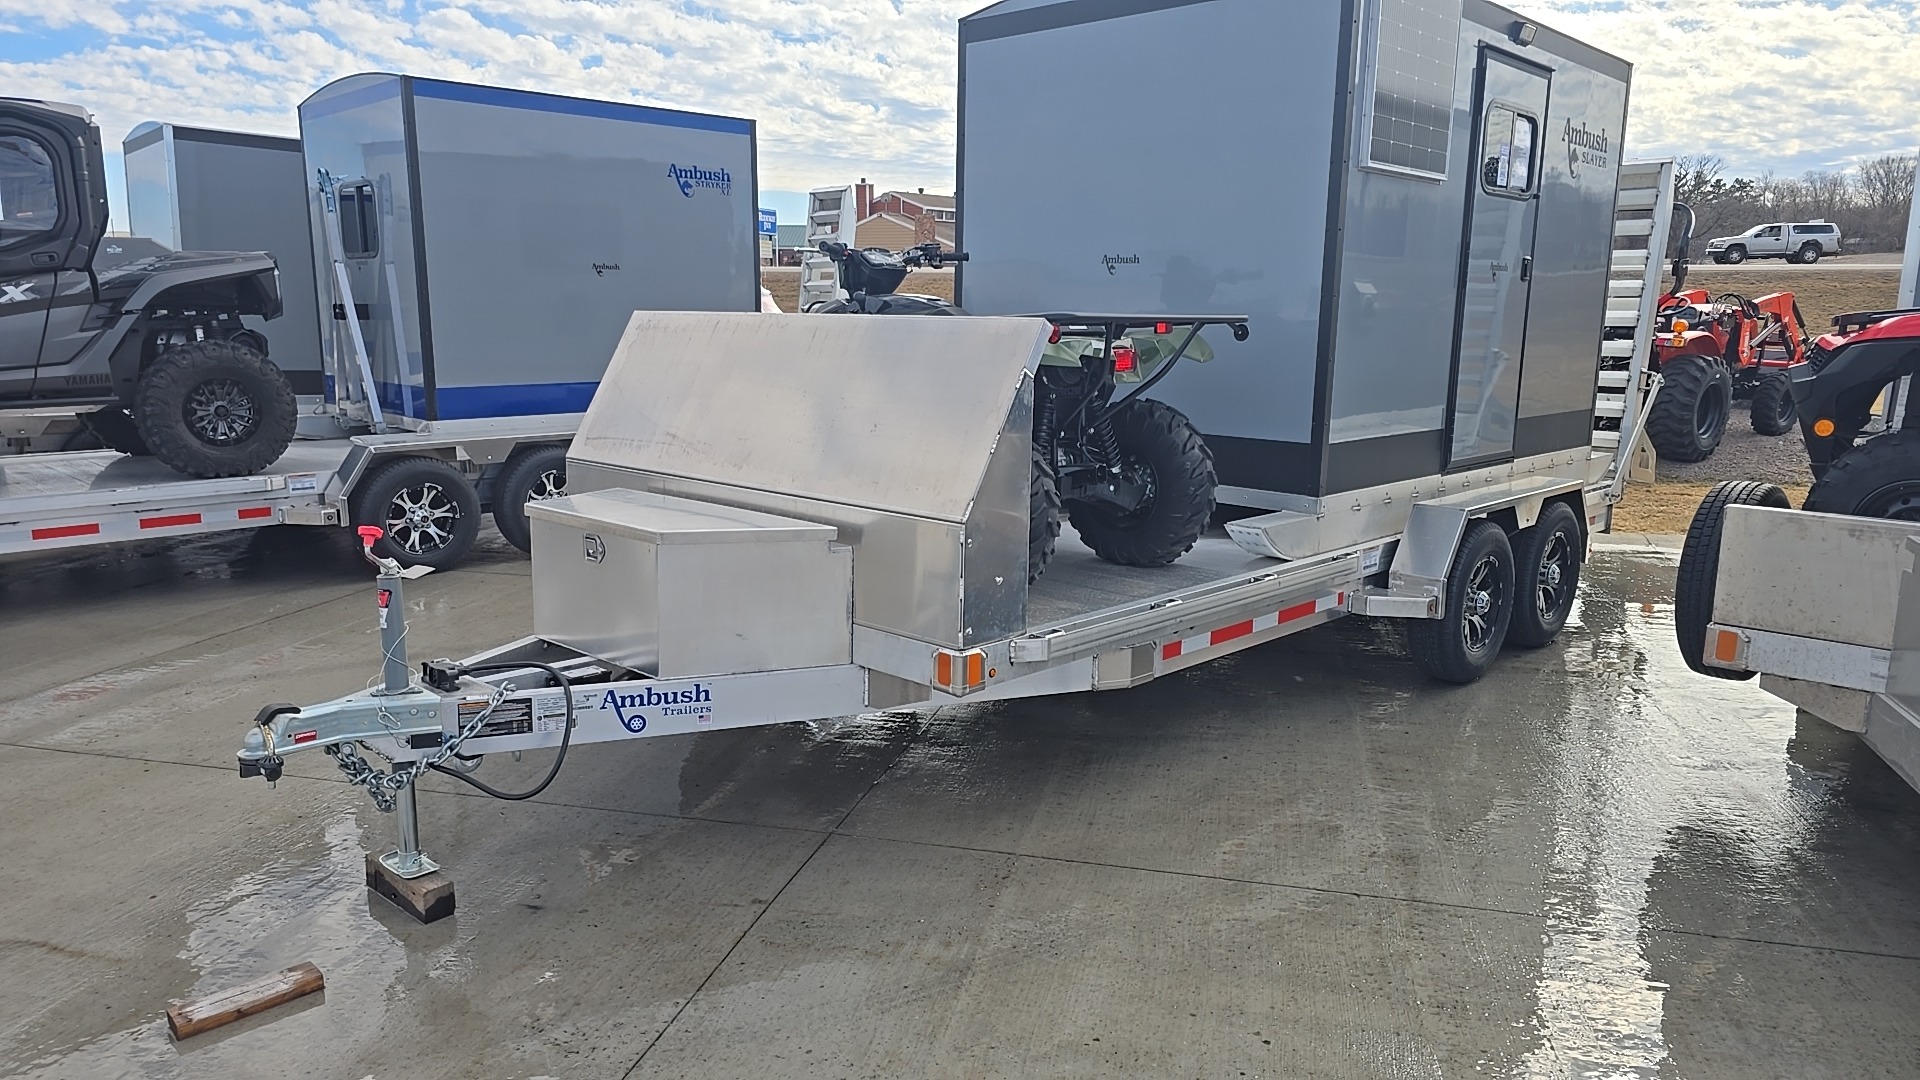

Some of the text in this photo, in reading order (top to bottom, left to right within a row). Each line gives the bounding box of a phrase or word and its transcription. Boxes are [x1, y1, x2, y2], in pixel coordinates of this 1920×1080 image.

[1562, 117, 1607, 178] Ambush
[1582, 151, 1607, 169] SLAYER
[695, 180, 732, 191] STRYKER
[64, 373, 112, 386] YAMAHA
[662, 705, 712, 716] Trailers
